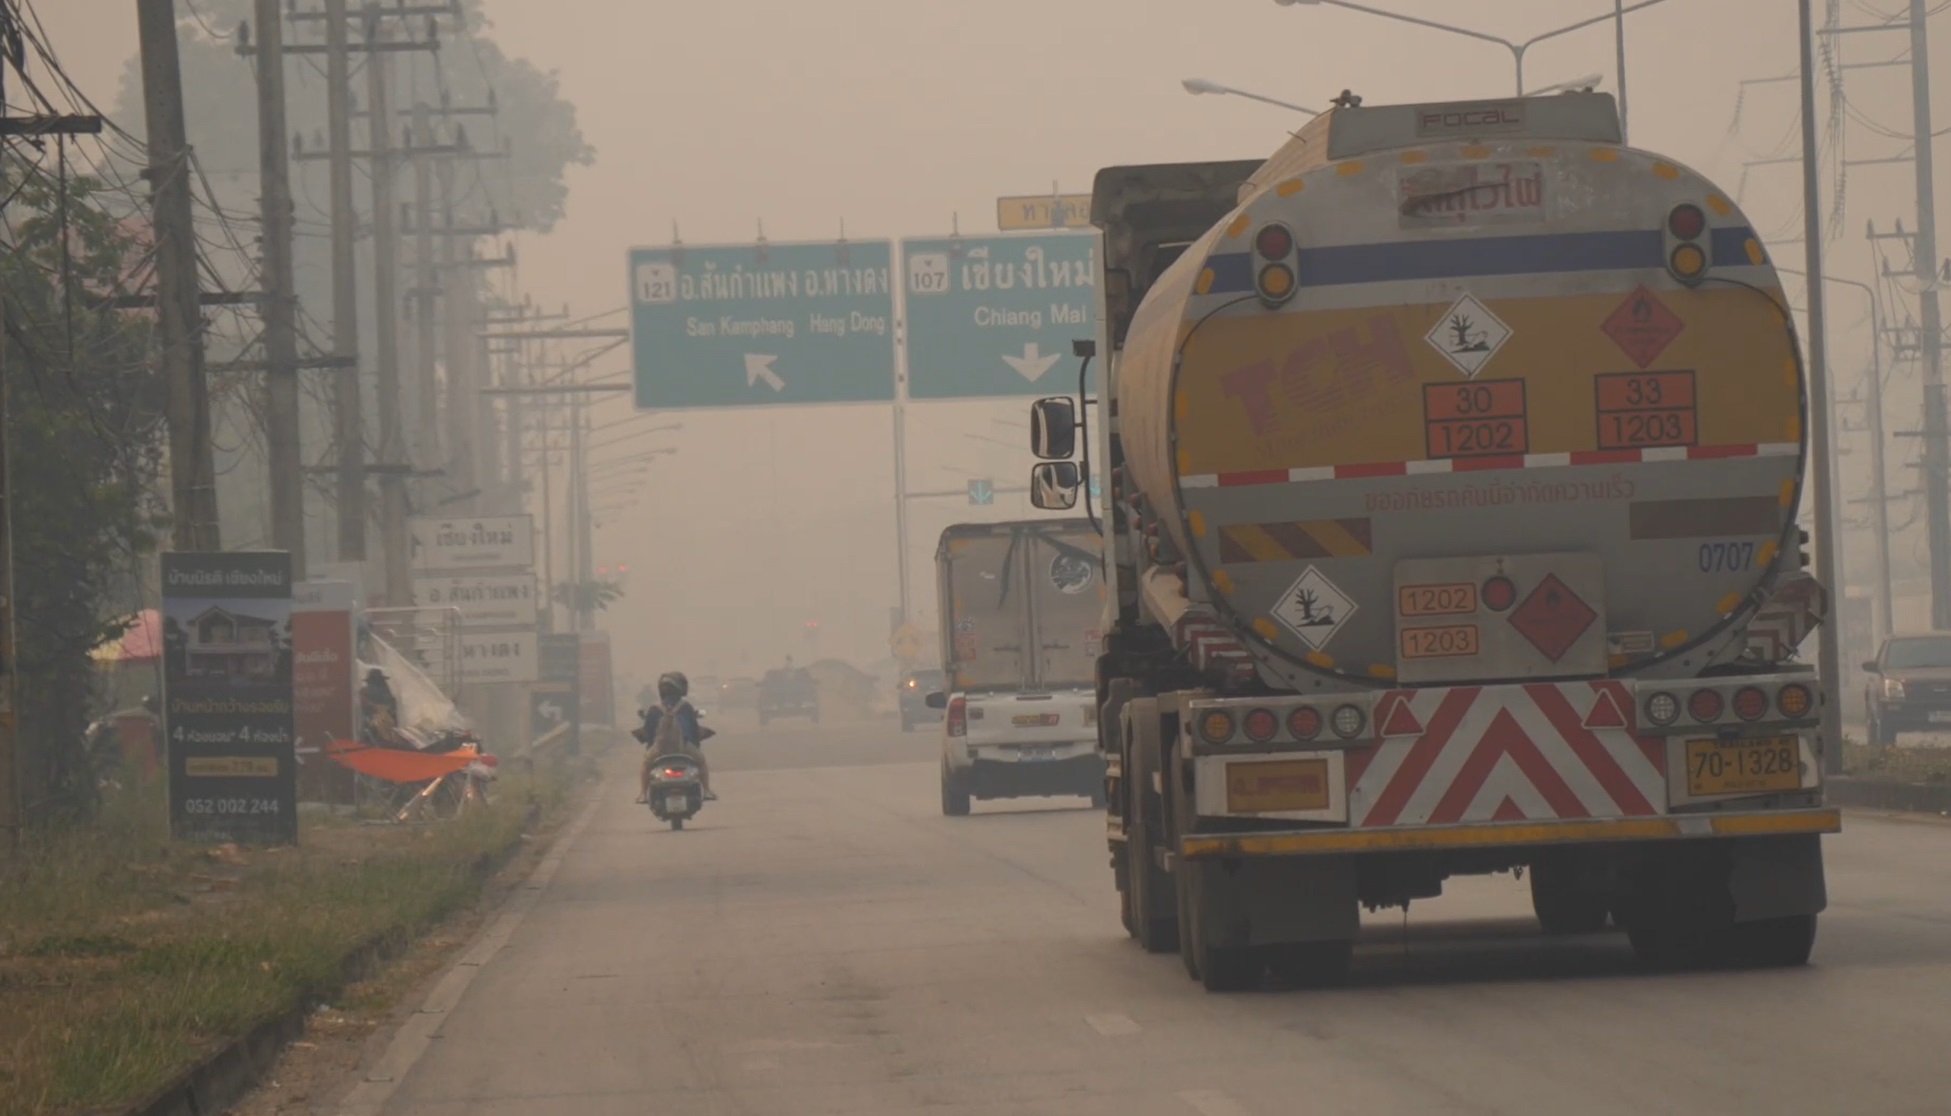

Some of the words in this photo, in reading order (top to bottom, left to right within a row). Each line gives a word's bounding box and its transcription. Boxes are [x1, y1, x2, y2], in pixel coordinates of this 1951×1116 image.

[681, 261, 798, 300] อ.สันกำแพง
[805, 267, 889, 297] อ.หางดง
[913, 272, 945, 289] 107
[961, 246, 1095, 290] เชียงใหม่
[643, 282, 671, 299] 121
[686, 316, 715, 337] San
[809, 313, 846, 336] Hang
[850, 311, 886, 336] Dong
[974, 306, 1042, 329] Chiang
[1050, 304, 1087, 324] Mai
[1456, 386, 1493, 414] 30
[1625, 378, 1663, 405] 33
[1441, 422, 1514, 452] 1202
[1613, 413, 1683, 442] 1203
[436, 522, 513, 547] เชียงใหม่
[1698, 542, 1754, 573] 0707
[1407, 588, 1468, 611] 1202
[1408, 630, 1471, 654] 1203
[172, 725, 184, 742] 4
[238, 725, 250, 742] 4
[1694, 747, 1793, 779] 70-1328
[185, 798, 215, 814] 052
[217, 798, 247, 814] 002
[249, 798, 280, 814] 244
